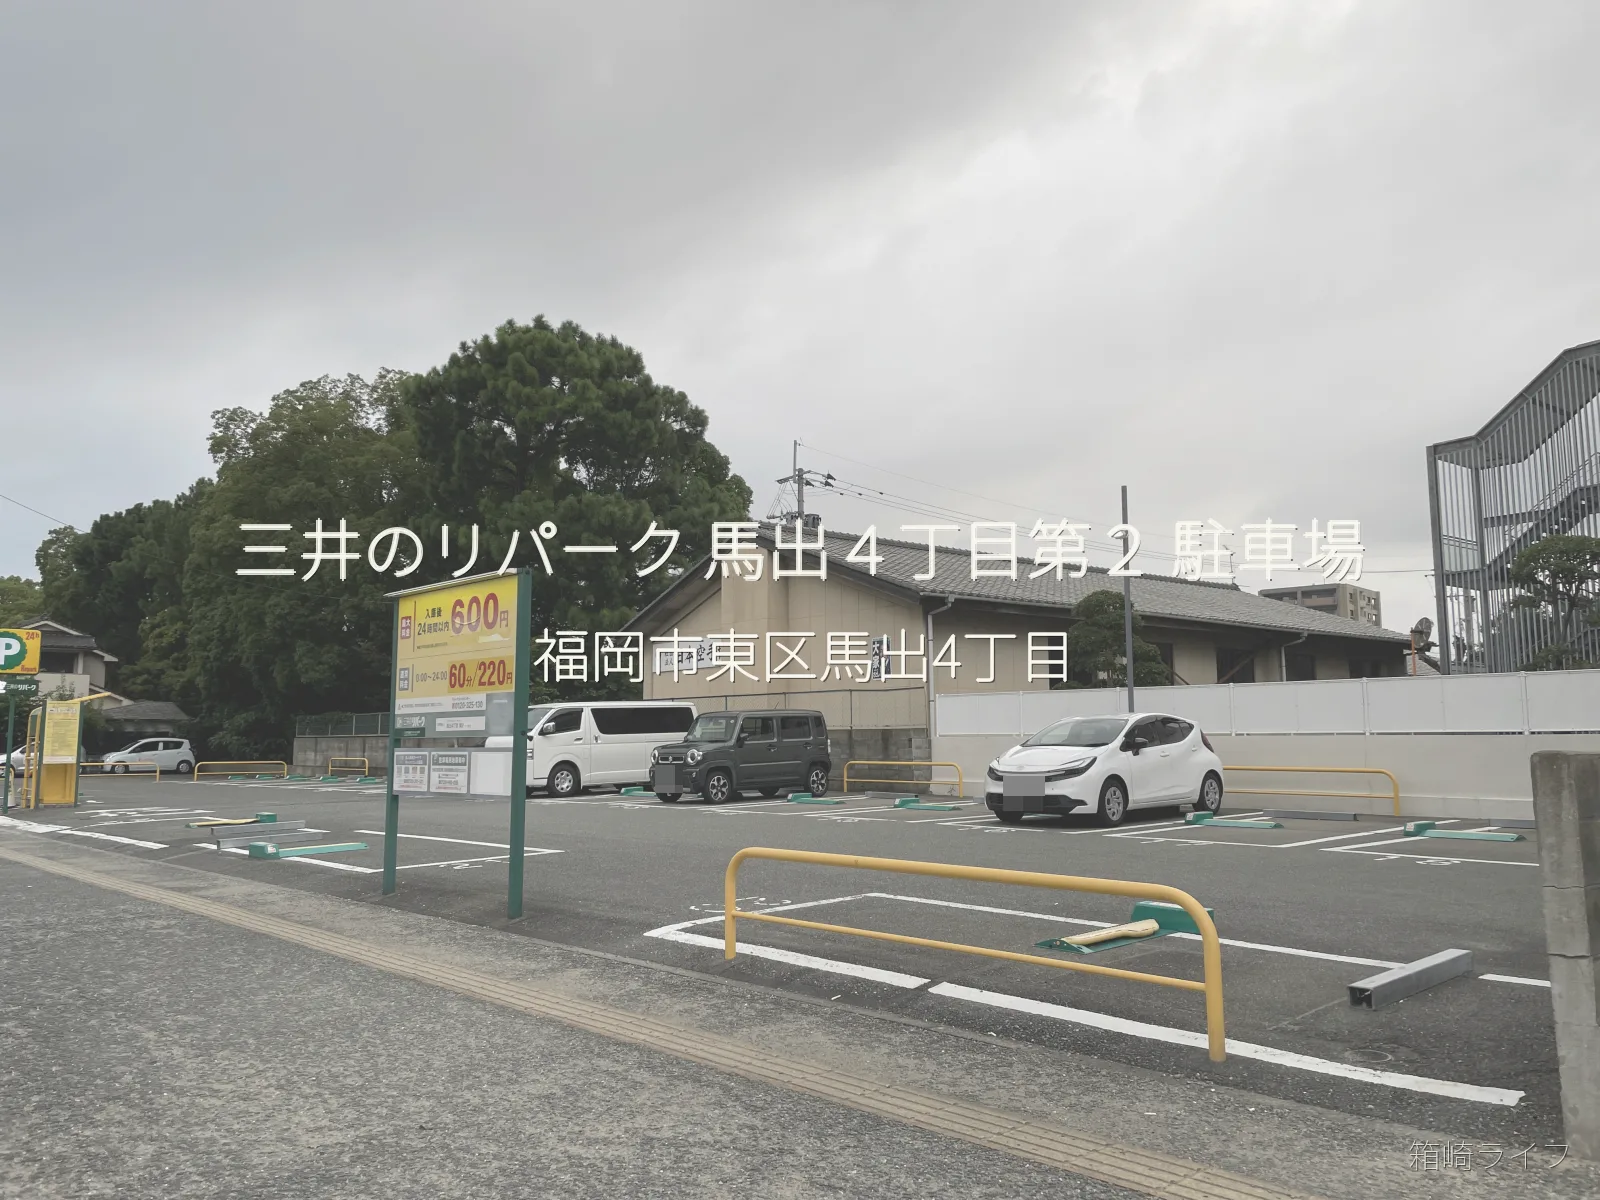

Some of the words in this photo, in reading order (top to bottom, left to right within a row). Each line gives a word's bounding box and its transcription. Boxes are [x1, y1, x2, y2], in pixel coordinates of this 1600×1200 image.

[417, 622, 450, 636] 24時間以内
[0, 637, 21, 665] P
